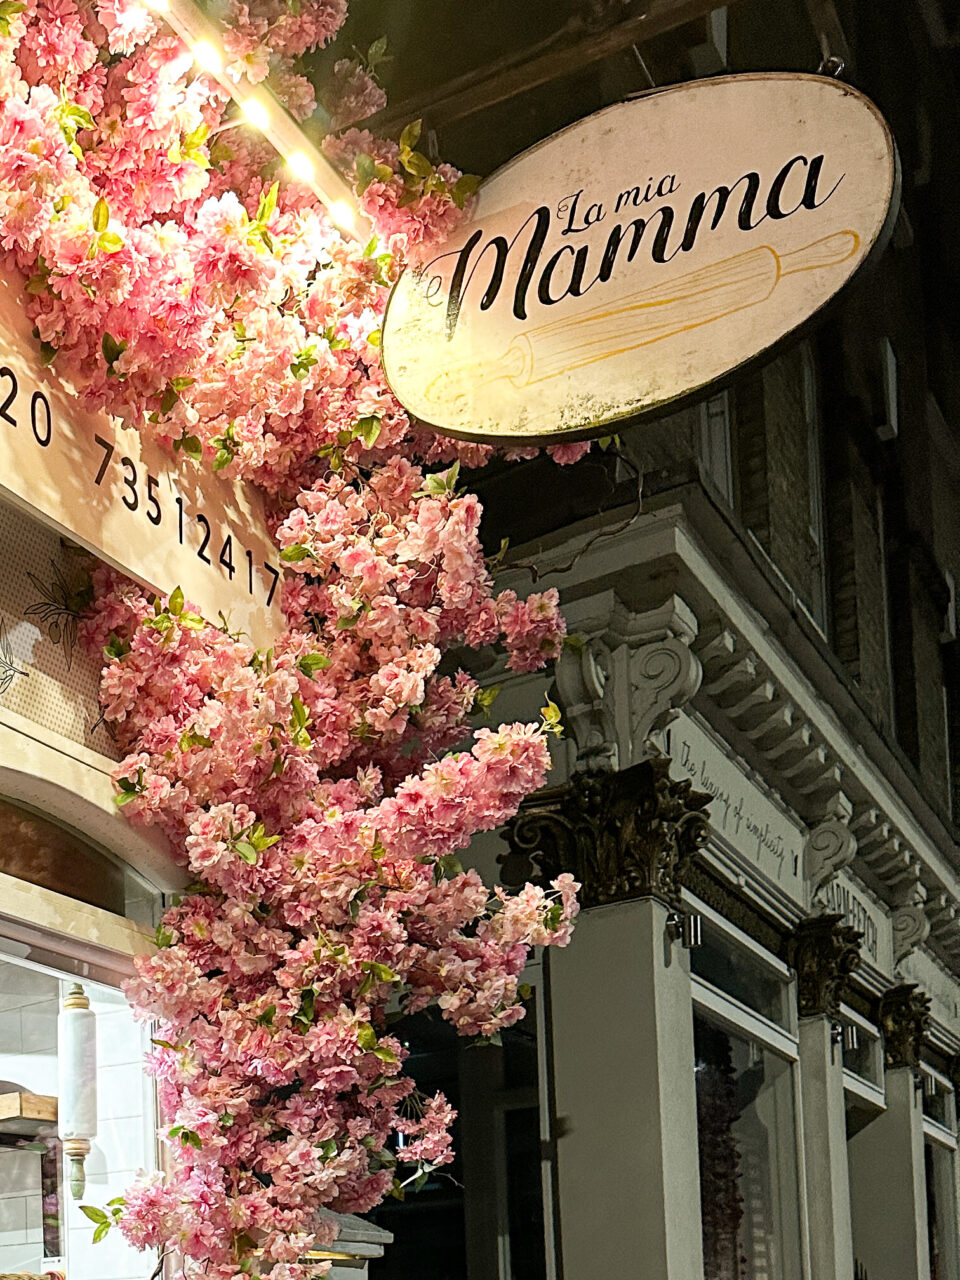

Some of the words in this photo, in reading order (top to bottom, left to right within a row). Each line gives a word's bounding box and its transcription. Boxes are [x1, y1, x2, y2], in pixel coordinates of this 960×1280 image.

[424, 155, 846, 341] Mamma
[557, 189, 607, 236] La
[615, 175, 680, 213] mia
